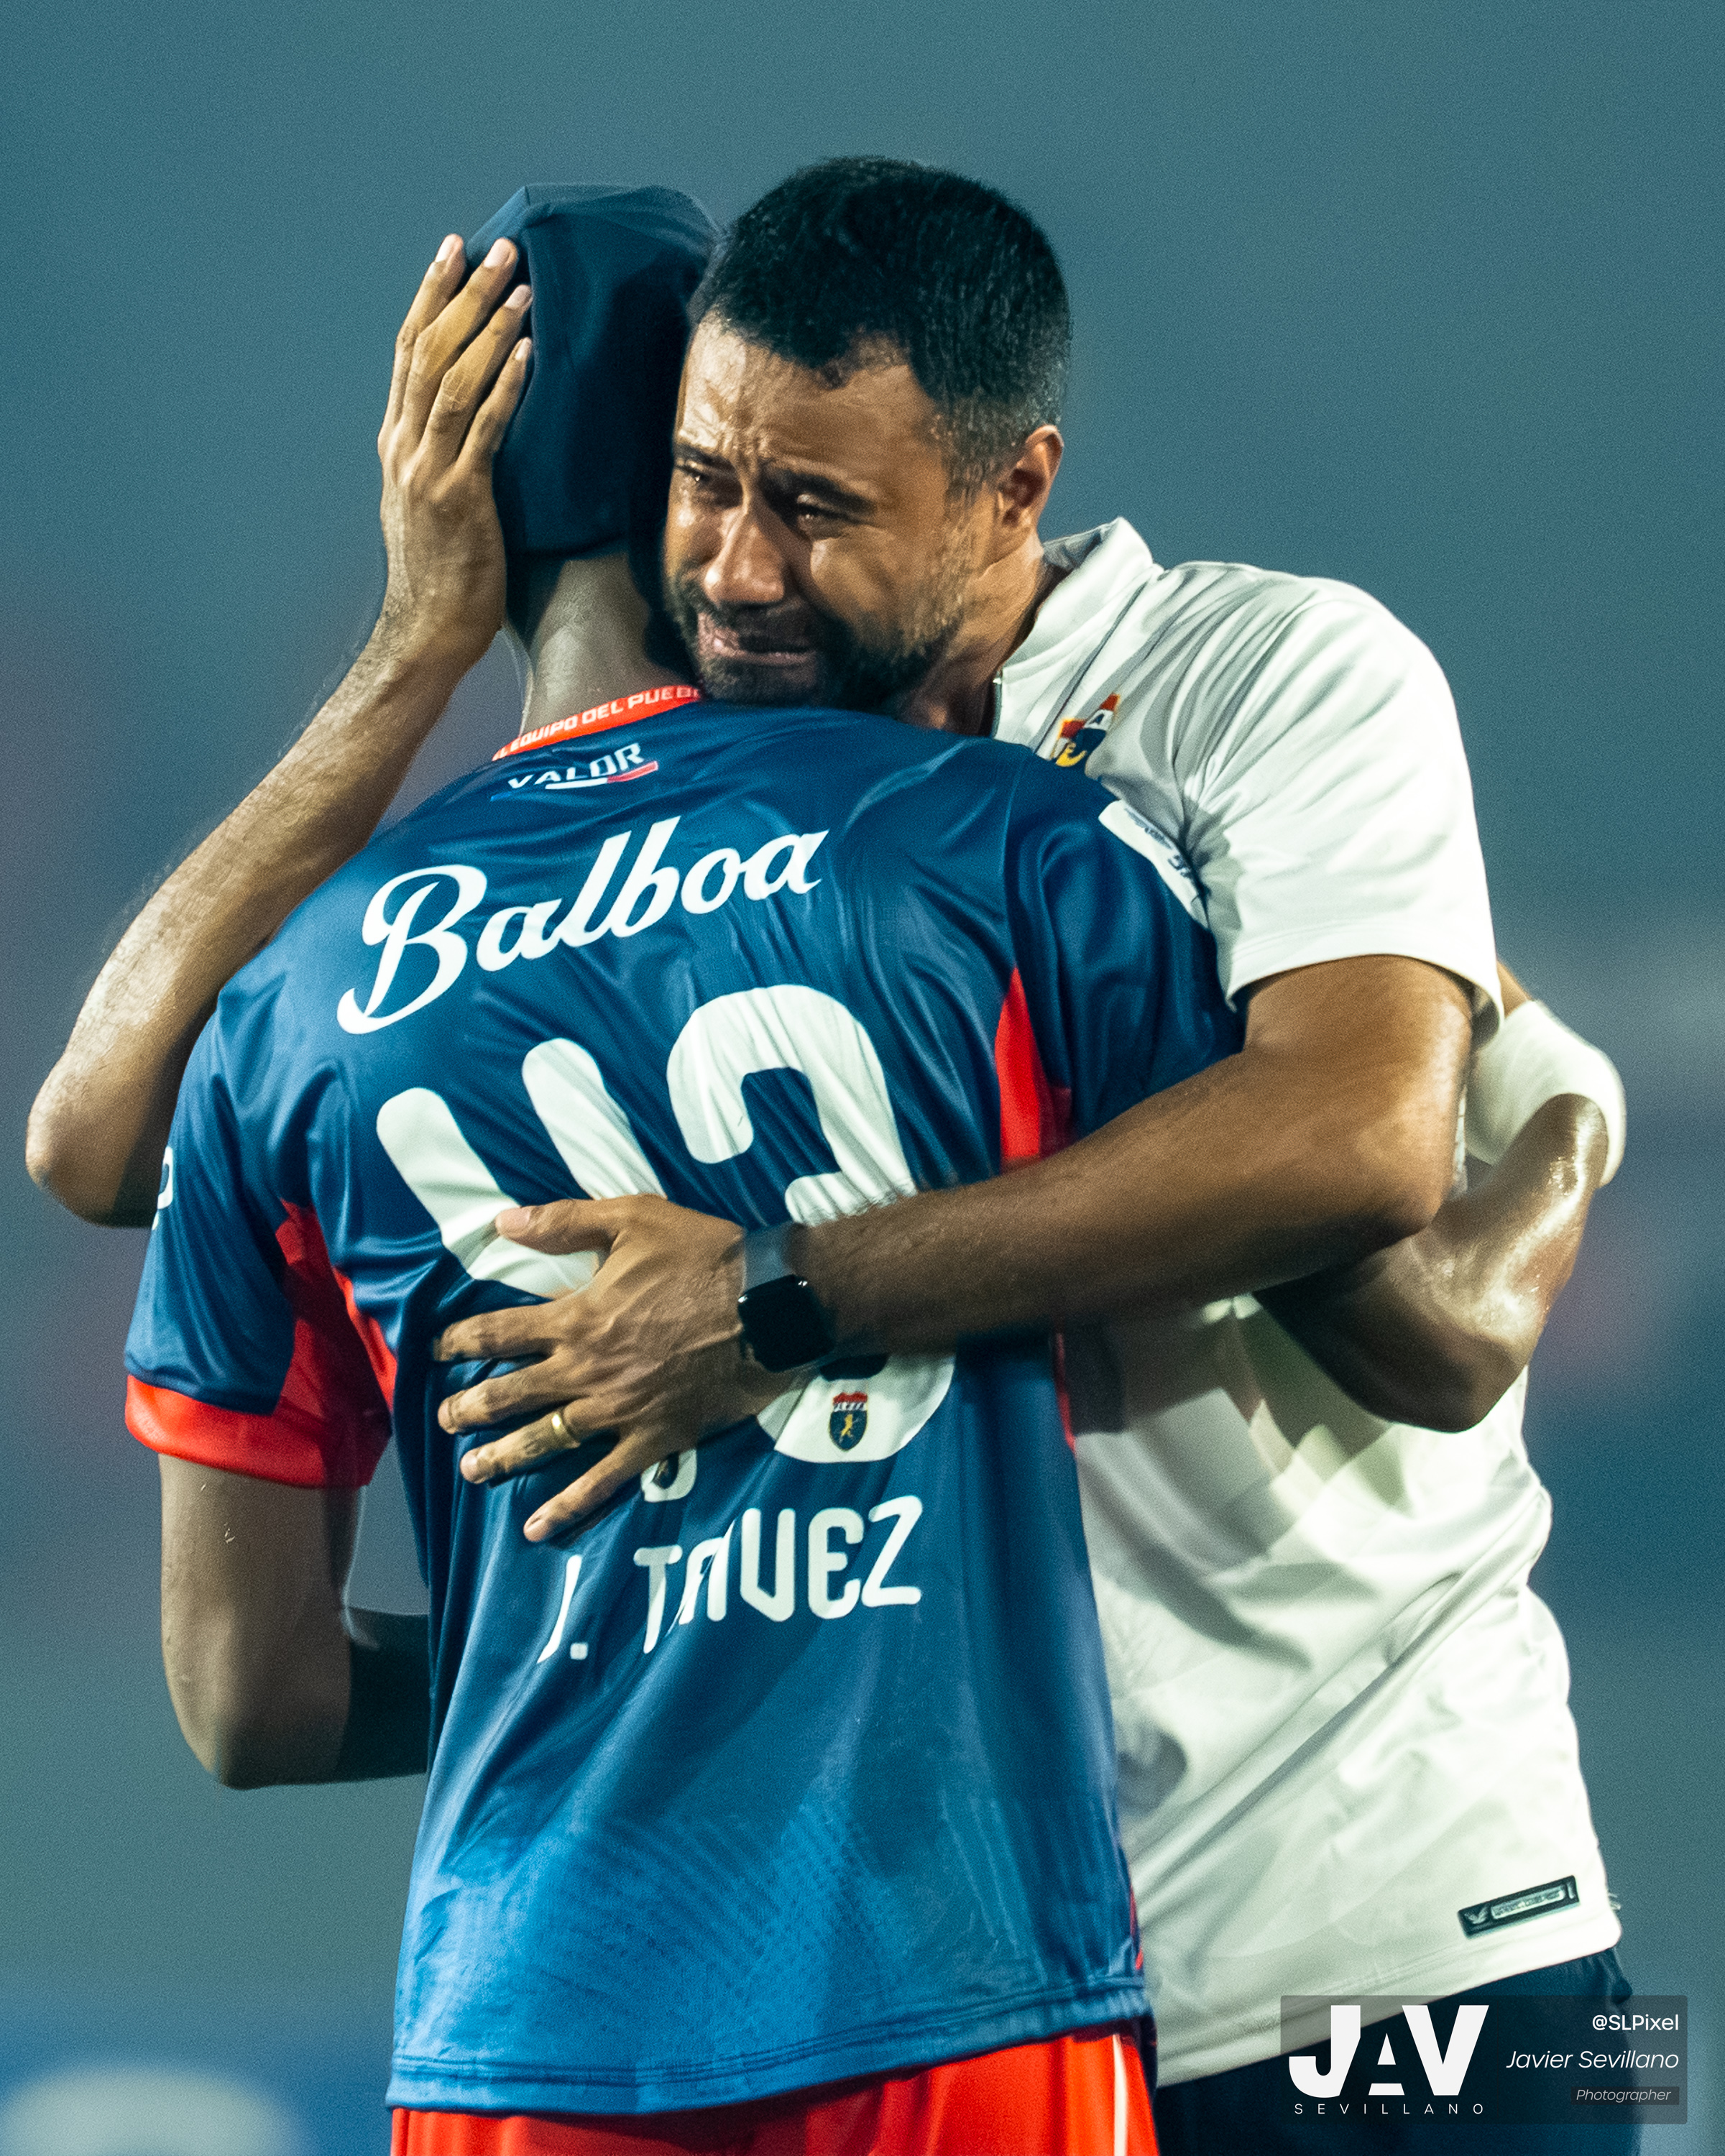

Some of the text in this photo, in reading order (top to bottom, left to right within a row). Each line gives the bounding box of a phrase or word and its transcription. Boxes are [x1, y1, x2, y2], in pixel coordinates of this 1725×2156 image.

[510, 716, 577, 751] EQUIPO
[581, 702, 624, 724] DEL
[627, 686, 699, 709] PUEB
[507, 742, 645, 789] VALOR
[336, 815, 829, 1035] Balboa
[538, 1554, 589, 1664] J.
